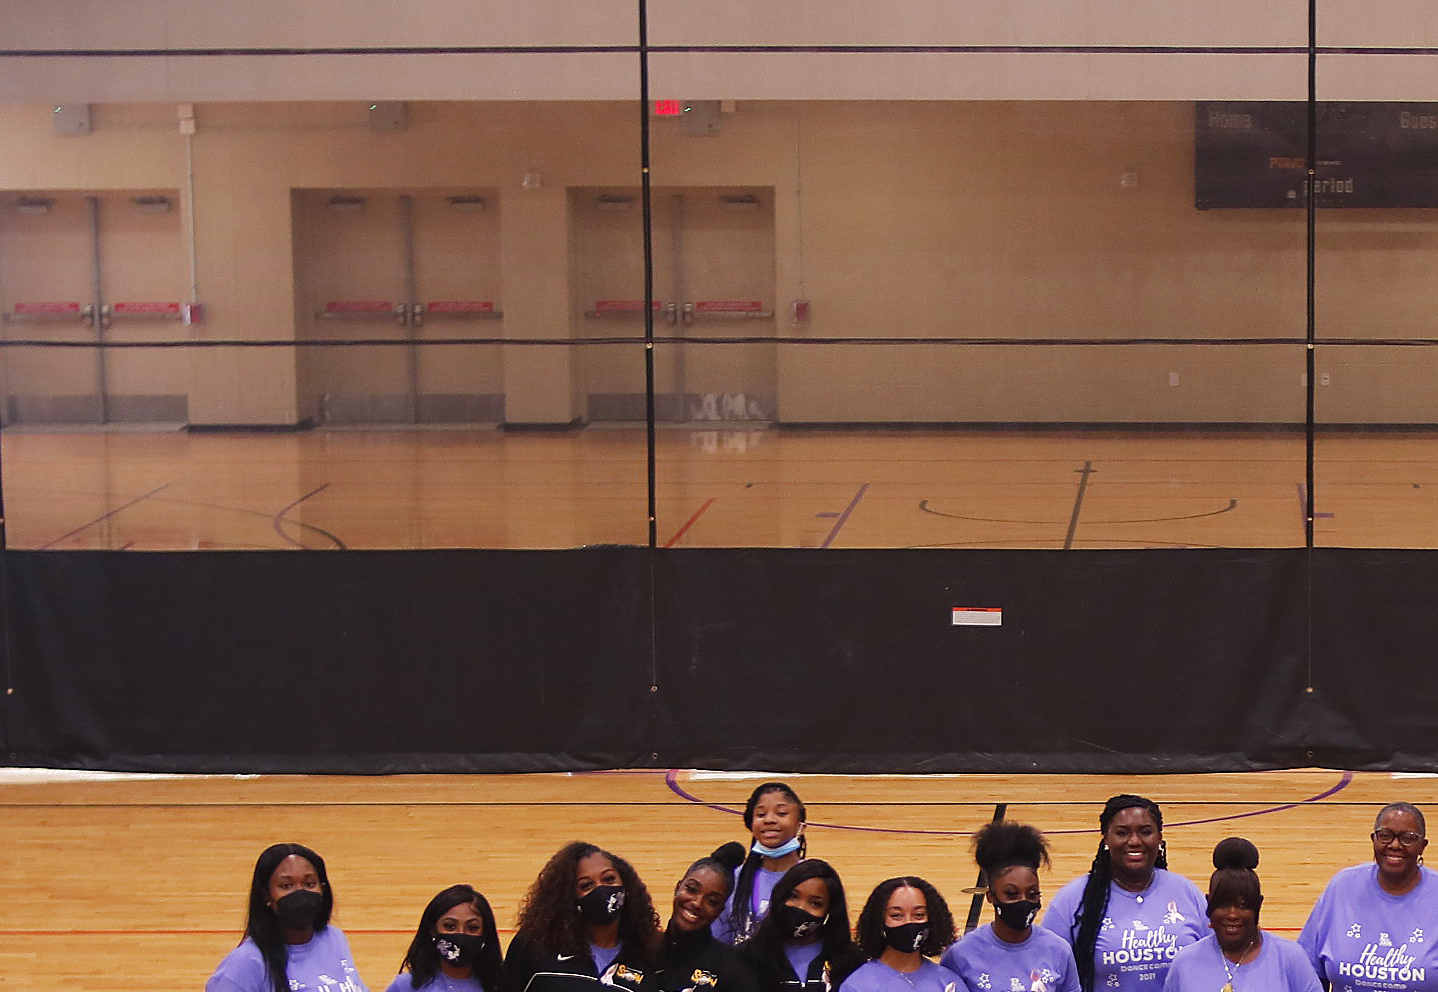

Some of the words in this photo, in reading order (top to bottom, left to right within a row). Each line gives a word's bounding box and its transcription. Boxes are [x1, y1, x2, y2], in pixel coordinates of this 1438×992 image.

[1121, 926, 1178, 952] Healthy
[1103, 946, 1183, 964] HOUSTO
[1359, 944, 1416, 973] Healthy
[1339, 962, 1425, 981] HOUSTON
